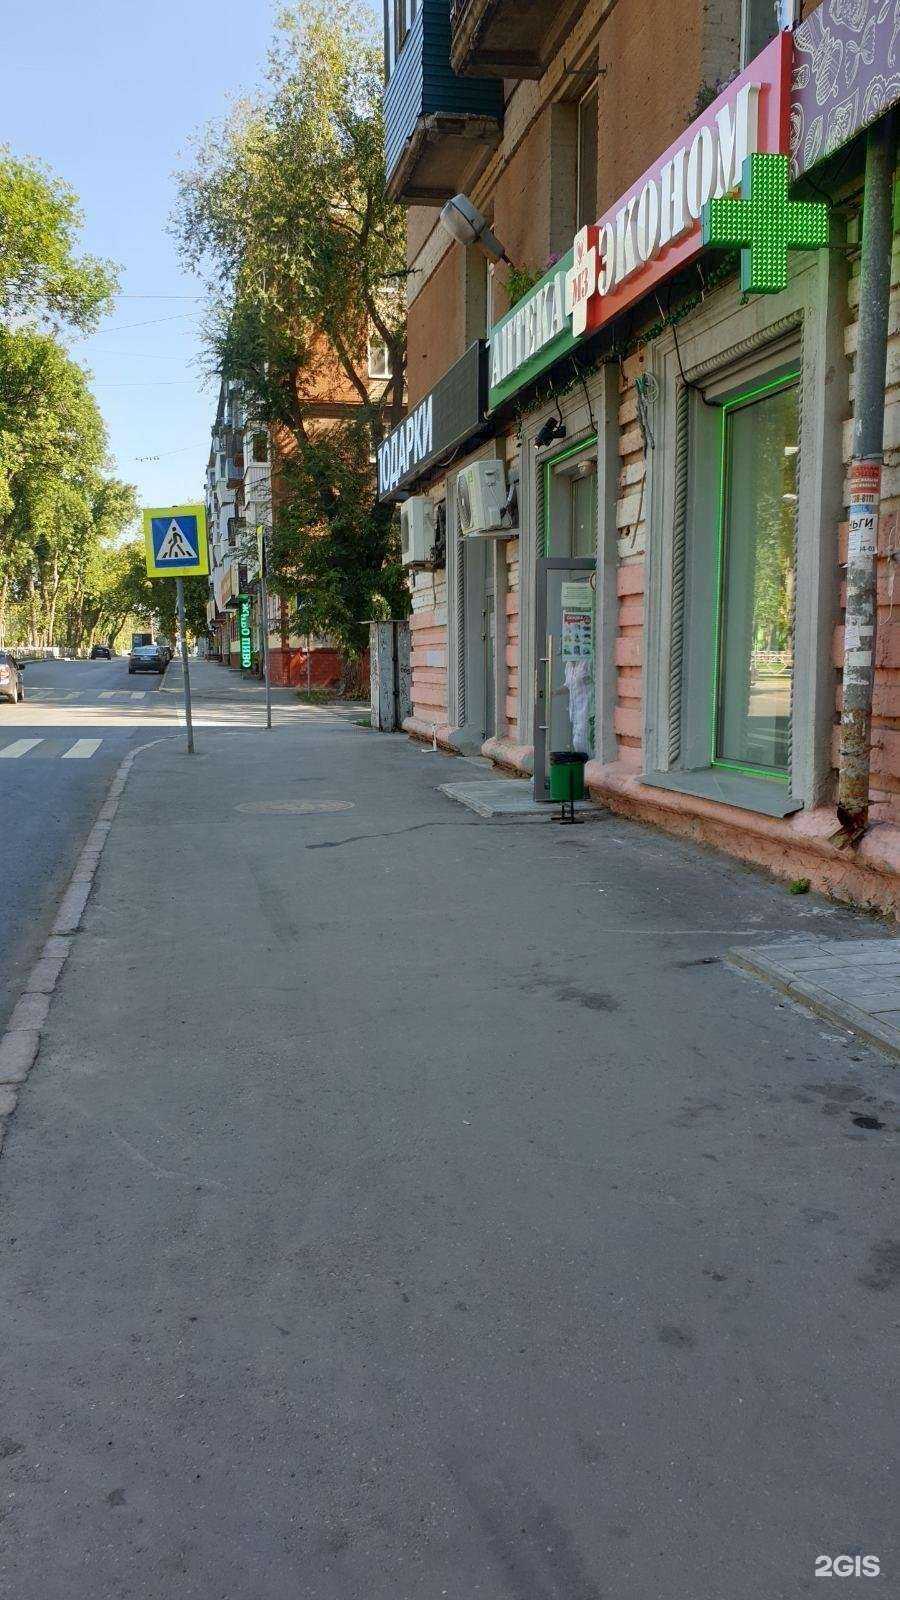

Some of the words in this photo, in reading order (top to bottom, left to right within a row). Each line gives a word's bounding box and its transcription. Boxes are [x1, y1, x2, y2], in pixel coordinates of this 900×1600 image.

[490, 271, 565, 388] АПТЕКА
[598, 82, 760, 296] ЭКОНОМ
[851, 518, 874, 530] ЬГИ
[241, 637, 251, 667] ПИВО
